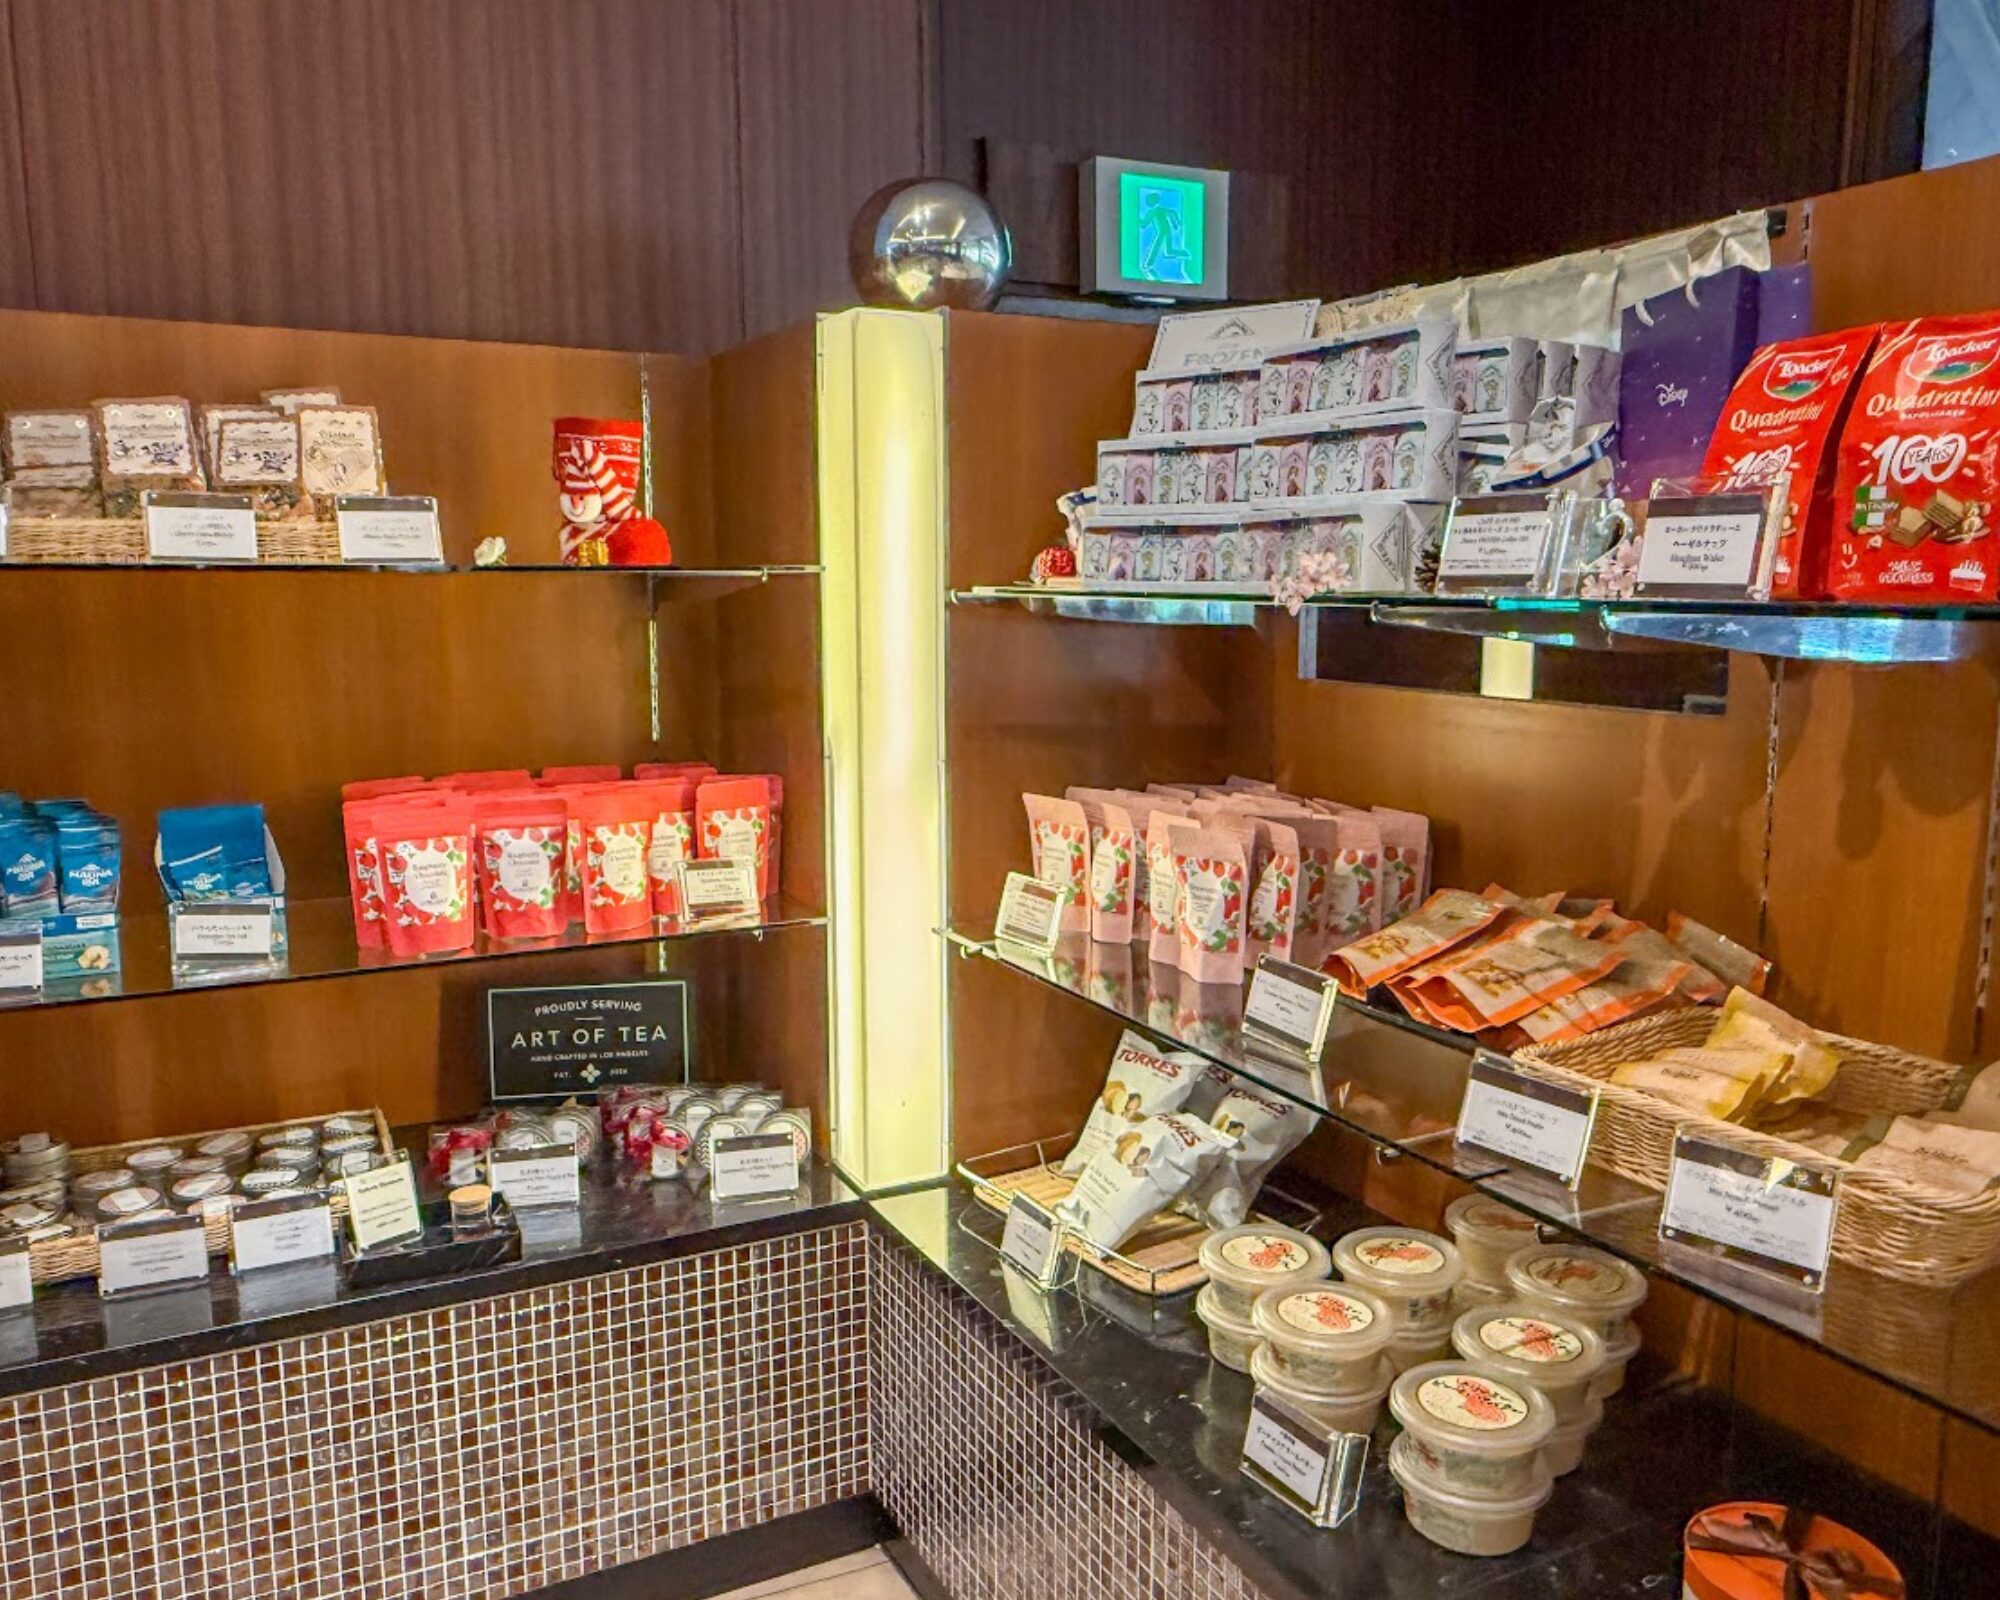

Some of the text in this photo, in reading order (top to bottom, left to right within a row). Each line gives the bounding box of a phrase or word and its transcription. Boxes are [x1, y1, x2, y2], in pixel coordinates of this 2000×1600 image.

[1926, 338, 1997, 362] Loacker
[1872, 432, 1967, 484] 100
[534, 999, 642, 1016] PROUDLY SERVING
[511, 1025, 667, 1048] ART OF TEA
[1117, 1049, 1182, 1079] TORRES
